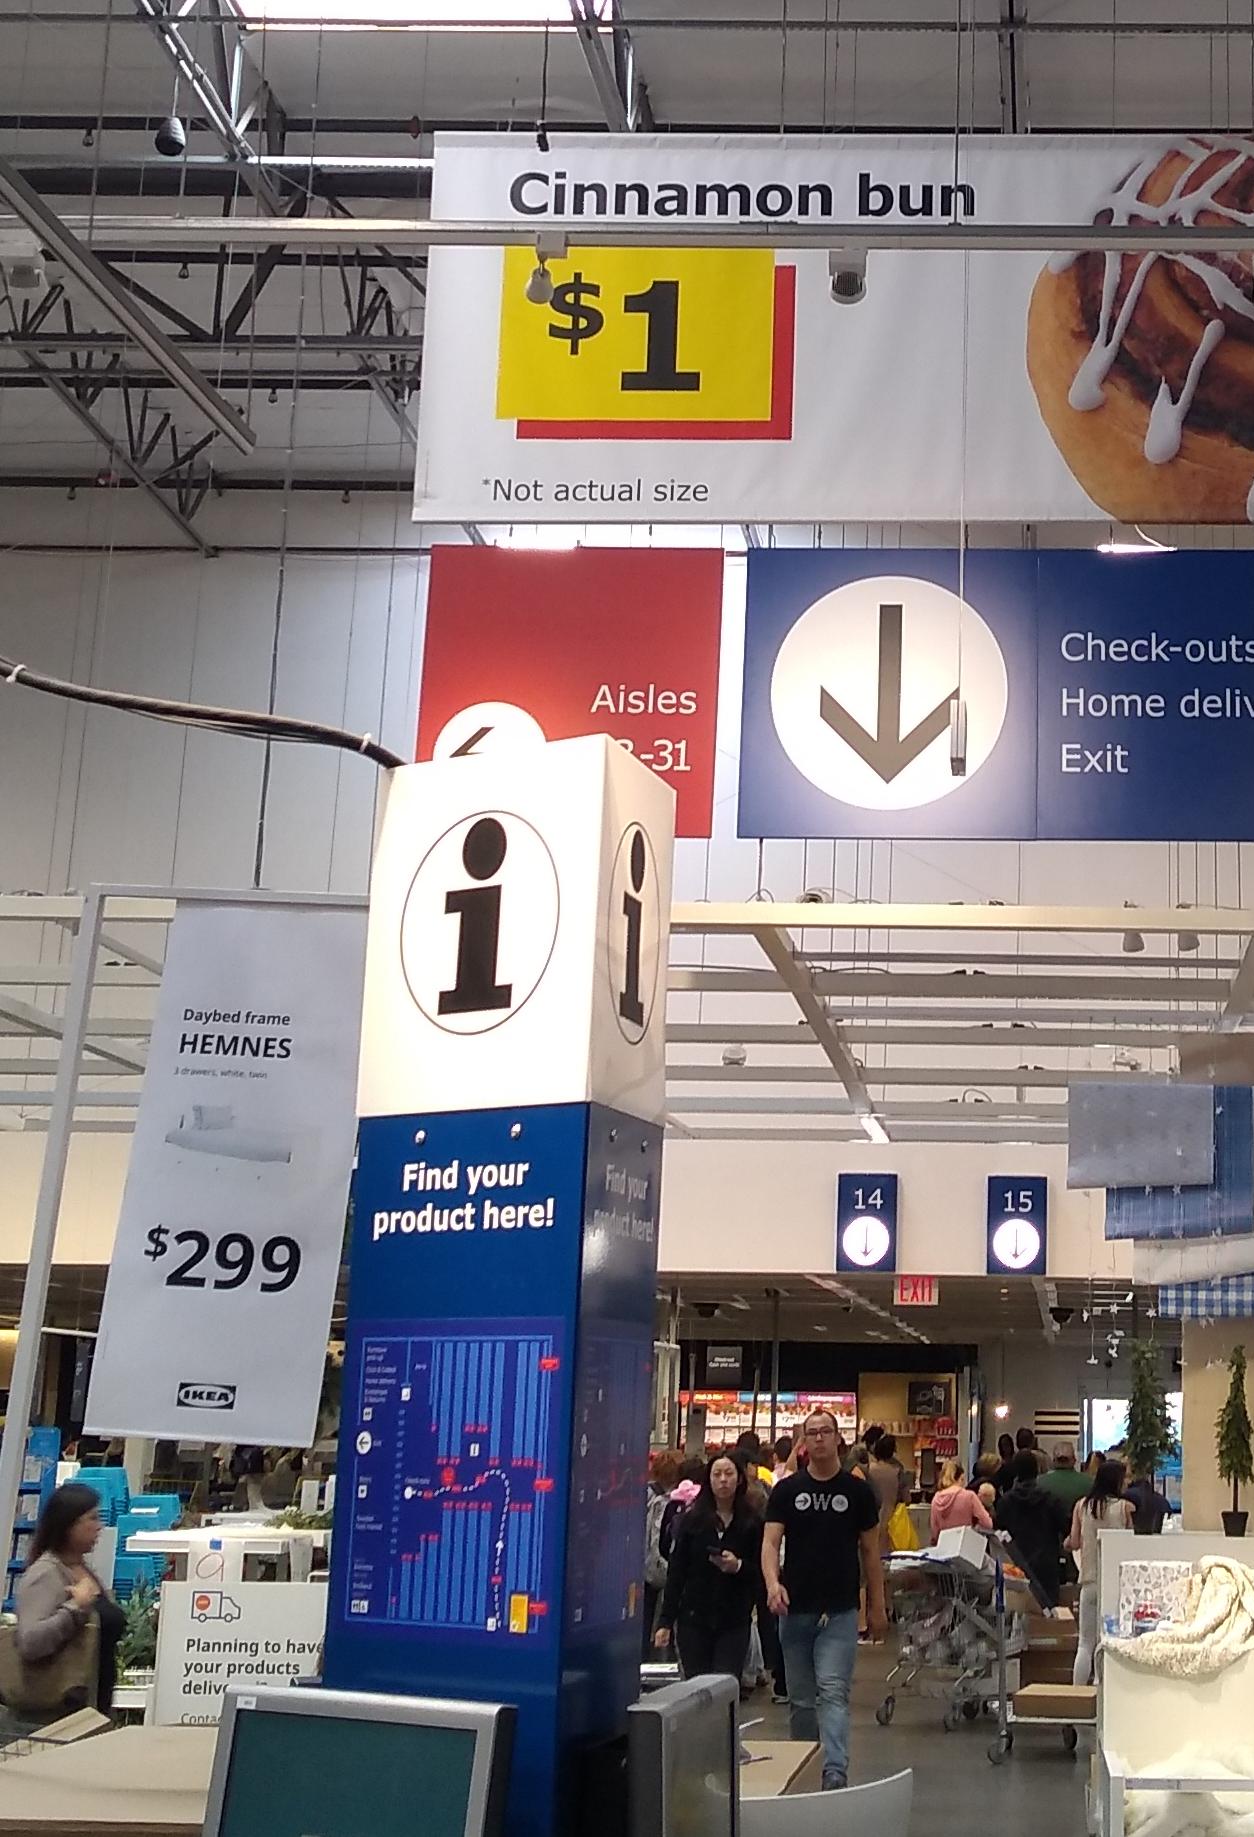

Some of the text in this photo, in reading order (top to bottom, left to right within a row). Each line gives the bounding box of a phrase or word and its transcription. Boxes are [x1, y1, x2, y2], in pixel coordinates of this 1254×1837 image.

[509, 171, 976, 217] Cinnamon bun
[547, 272, 701, 392] $1
[552, 477, 642, 503] actual
[653, 477, 709, 503] size
[590, 684, 698, 715] Aisles
[1060, 688, 1166, 719] Home
[1060, 742, 1129, 774] Exit
[183, 1008, 292, 1027] Daybed frame
[178, 1032, 293, 1060] HEMNES
[402, 1159, 531, 1196] Find your
[853, 1187, 884, 1210] 14
[1003, 1190, 1033, 1213] 15
[373, 1197, 556, 1242] product here!
[143, 1223, 302, 1293] $299
[899, 1276, 933, 1302] EXIT
[183, 1389, 231, 1402] IKEA
[186, 1638, 259, 1658] Planning
[264, 1640, 281, 1654] to
[182, 1659, 301, 1678] your products
